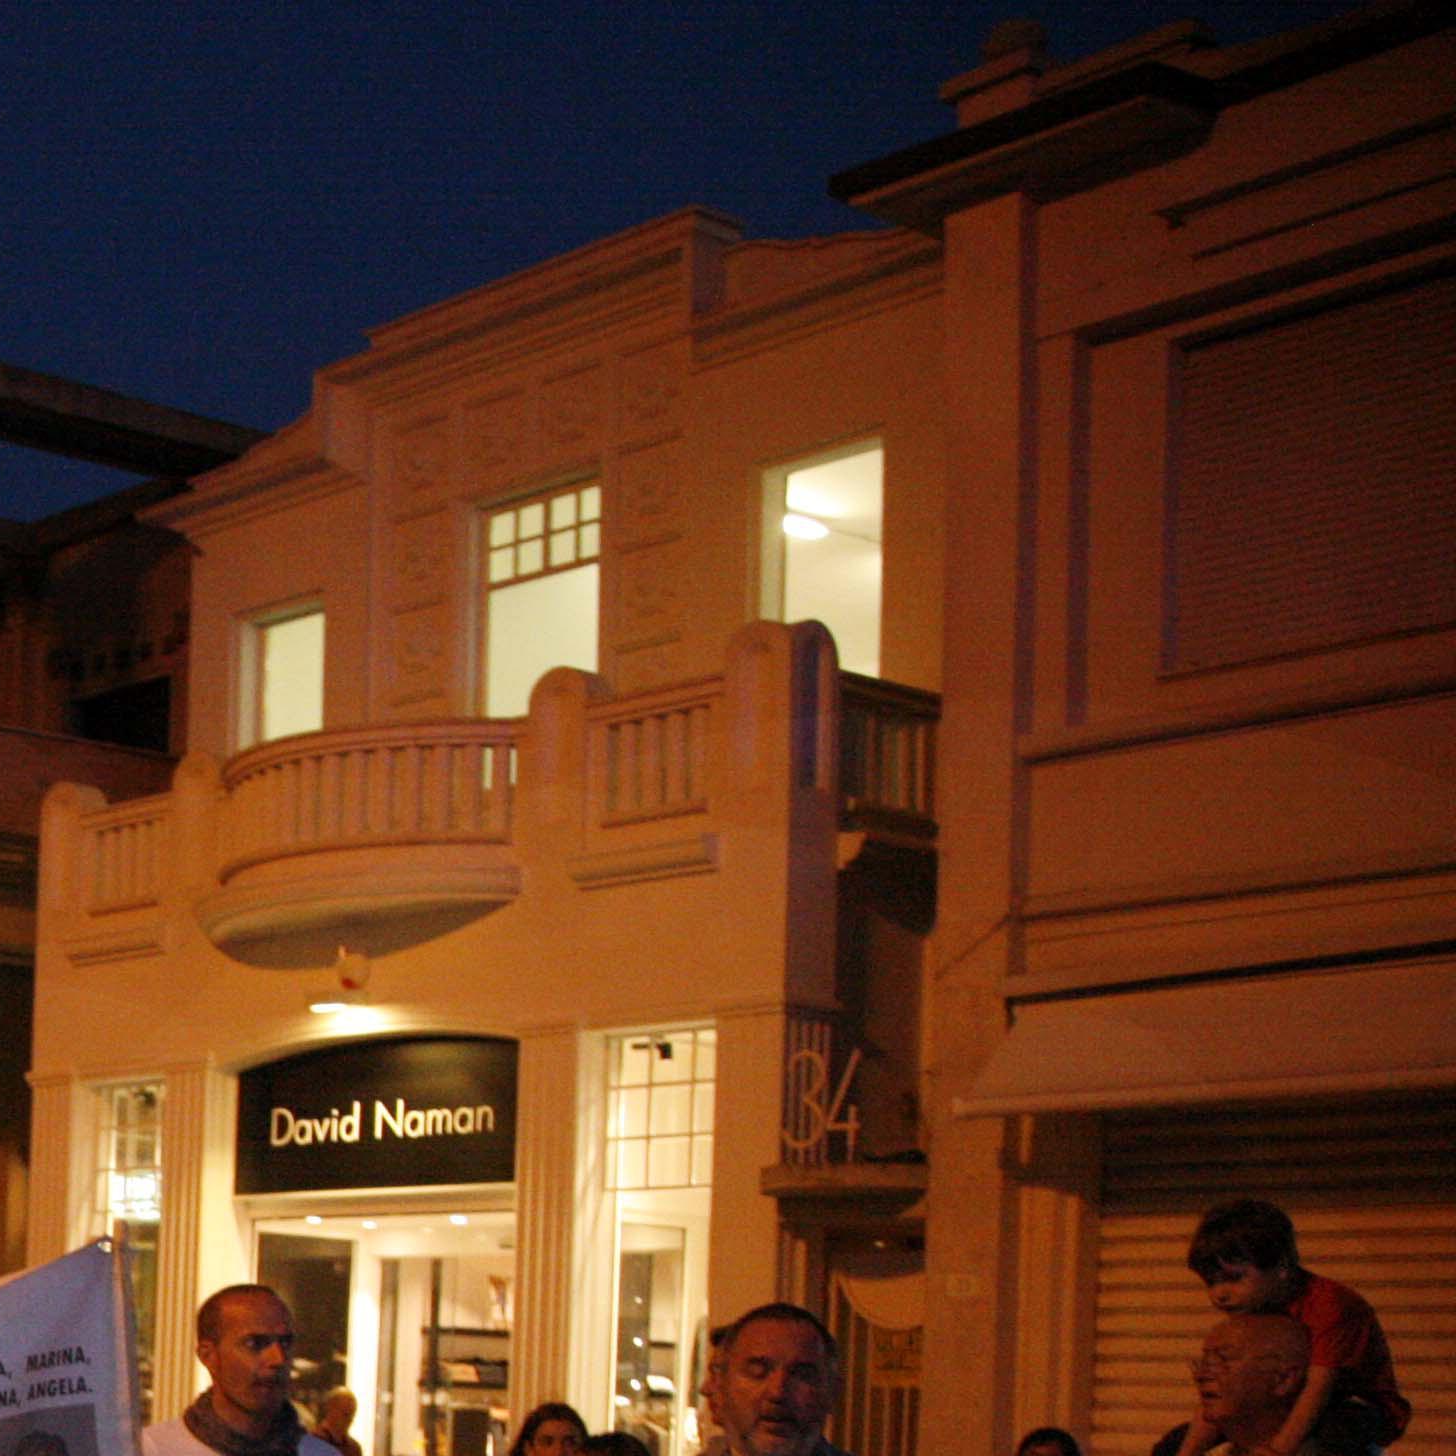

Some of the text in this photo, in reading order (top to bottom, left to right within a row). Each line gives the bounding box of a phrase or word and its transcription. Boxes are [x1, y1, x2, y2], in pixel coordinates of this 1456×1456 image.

[270, 1098, 494, 1147] David Naman
[783, 1049, 862, 1162] 34
[26, 1345, 91, 1373] MARINA,
